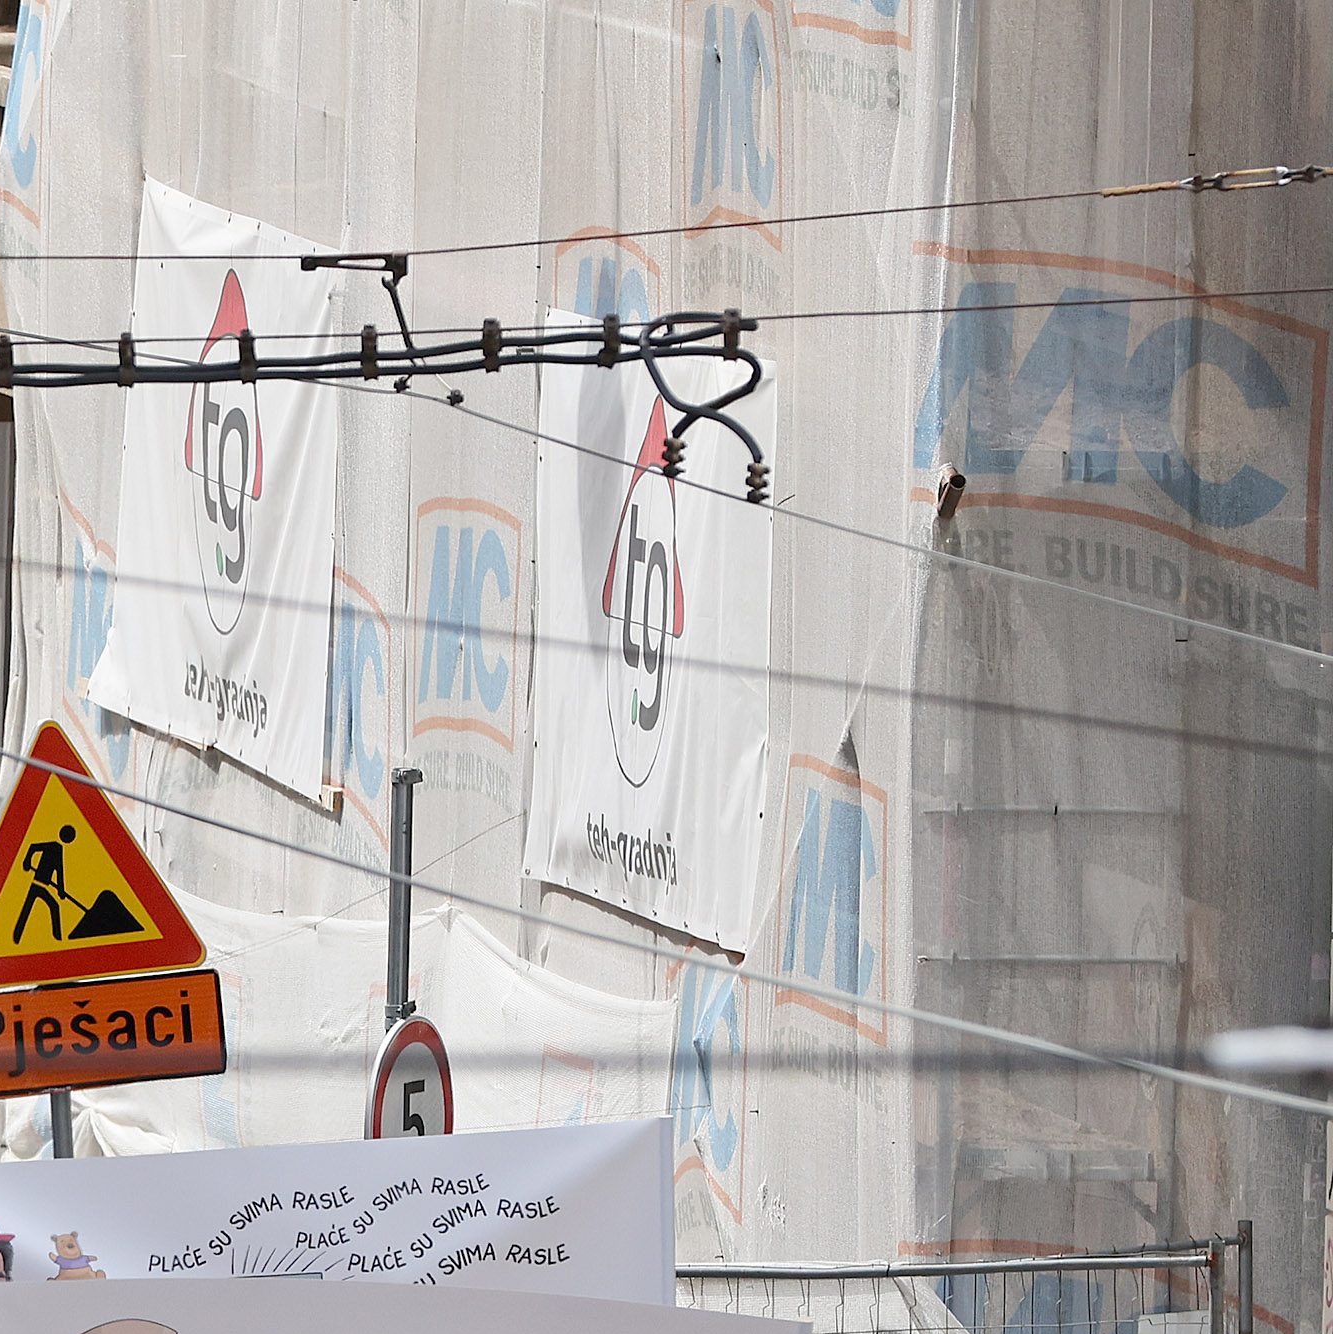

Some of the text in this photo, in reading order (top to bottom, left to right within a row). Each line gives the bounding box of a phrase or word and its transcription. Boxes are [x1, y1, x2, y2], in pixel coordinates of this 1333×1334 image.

[585, 811, 679, 897] teh-gradnja
[402, 1080, 426, 1137] 5
[148, 1186, 355, 1274] PLAĆE SU SVIMA RASLE
[295, 1173, 491, 1250] PLAĆE SU SVIMA RASLE
[347, 1195, 561, 1273] PLAĆE SU SVIMA RASLE
[438, 1242, 571, 1277] SVIMA RASLE
